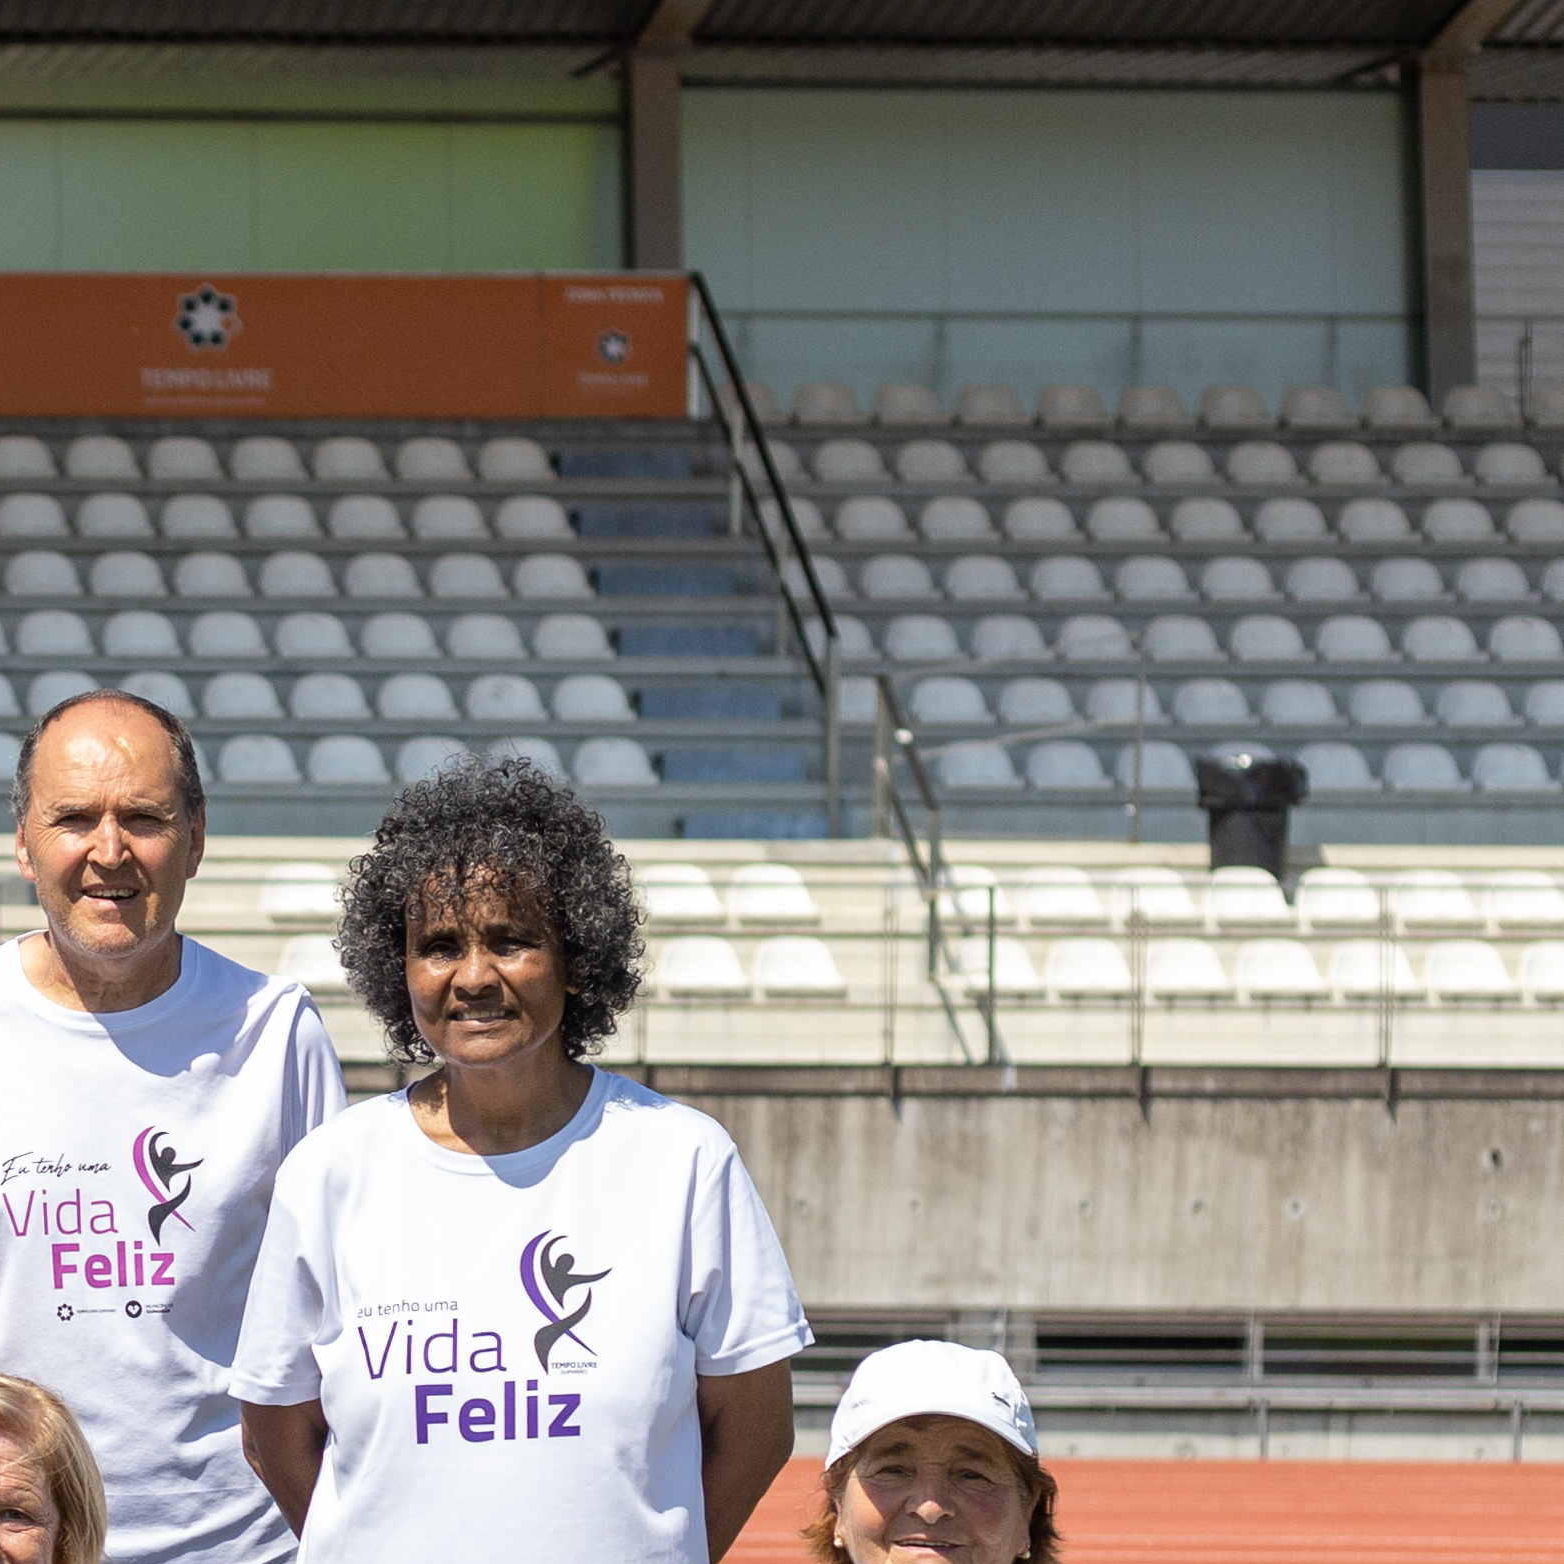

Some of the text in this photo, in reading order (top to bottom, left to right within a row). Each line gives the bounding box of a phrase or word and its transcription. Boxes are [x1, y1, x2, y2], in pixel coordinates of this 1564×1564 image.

[0, 1151, 111, 1186] Eu tenho uma
[2, 1188, 119, 1237] Vida
[51, 1240, 176, 1289] Feliz
[357, 1300, 458, 1318] eu tenho uma
[357, 1318, 507, 1380] Vida
[415, 1379, 581, 1444] Feliz
